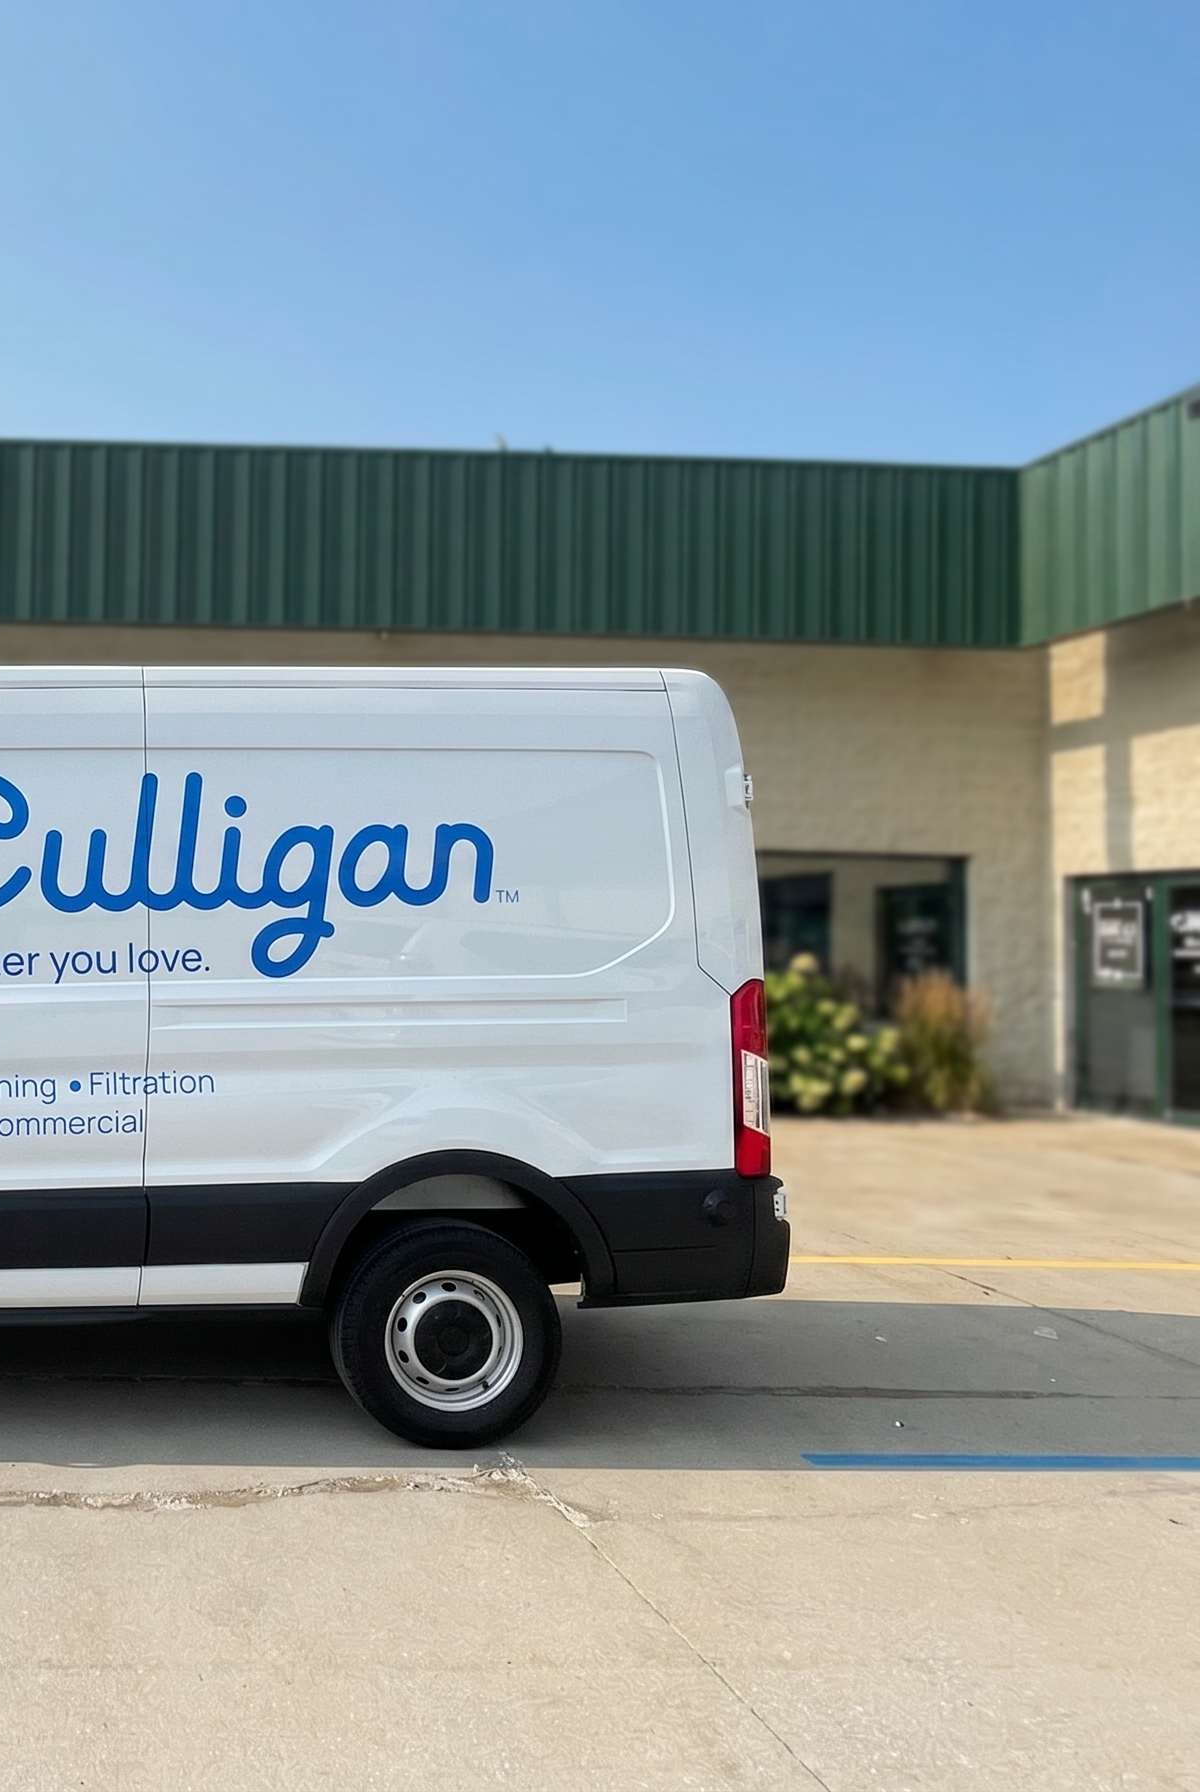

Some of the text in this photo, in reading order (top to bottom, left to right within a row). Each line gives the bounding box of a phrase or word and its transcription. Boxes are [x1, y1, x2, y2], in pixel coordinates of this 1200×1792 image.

[496, 889, 520, 904] TM
[49, 946, 117, 984] you
[127, 942, 211, 974] love.
[89, 1071, 216, 1097] Filtration
